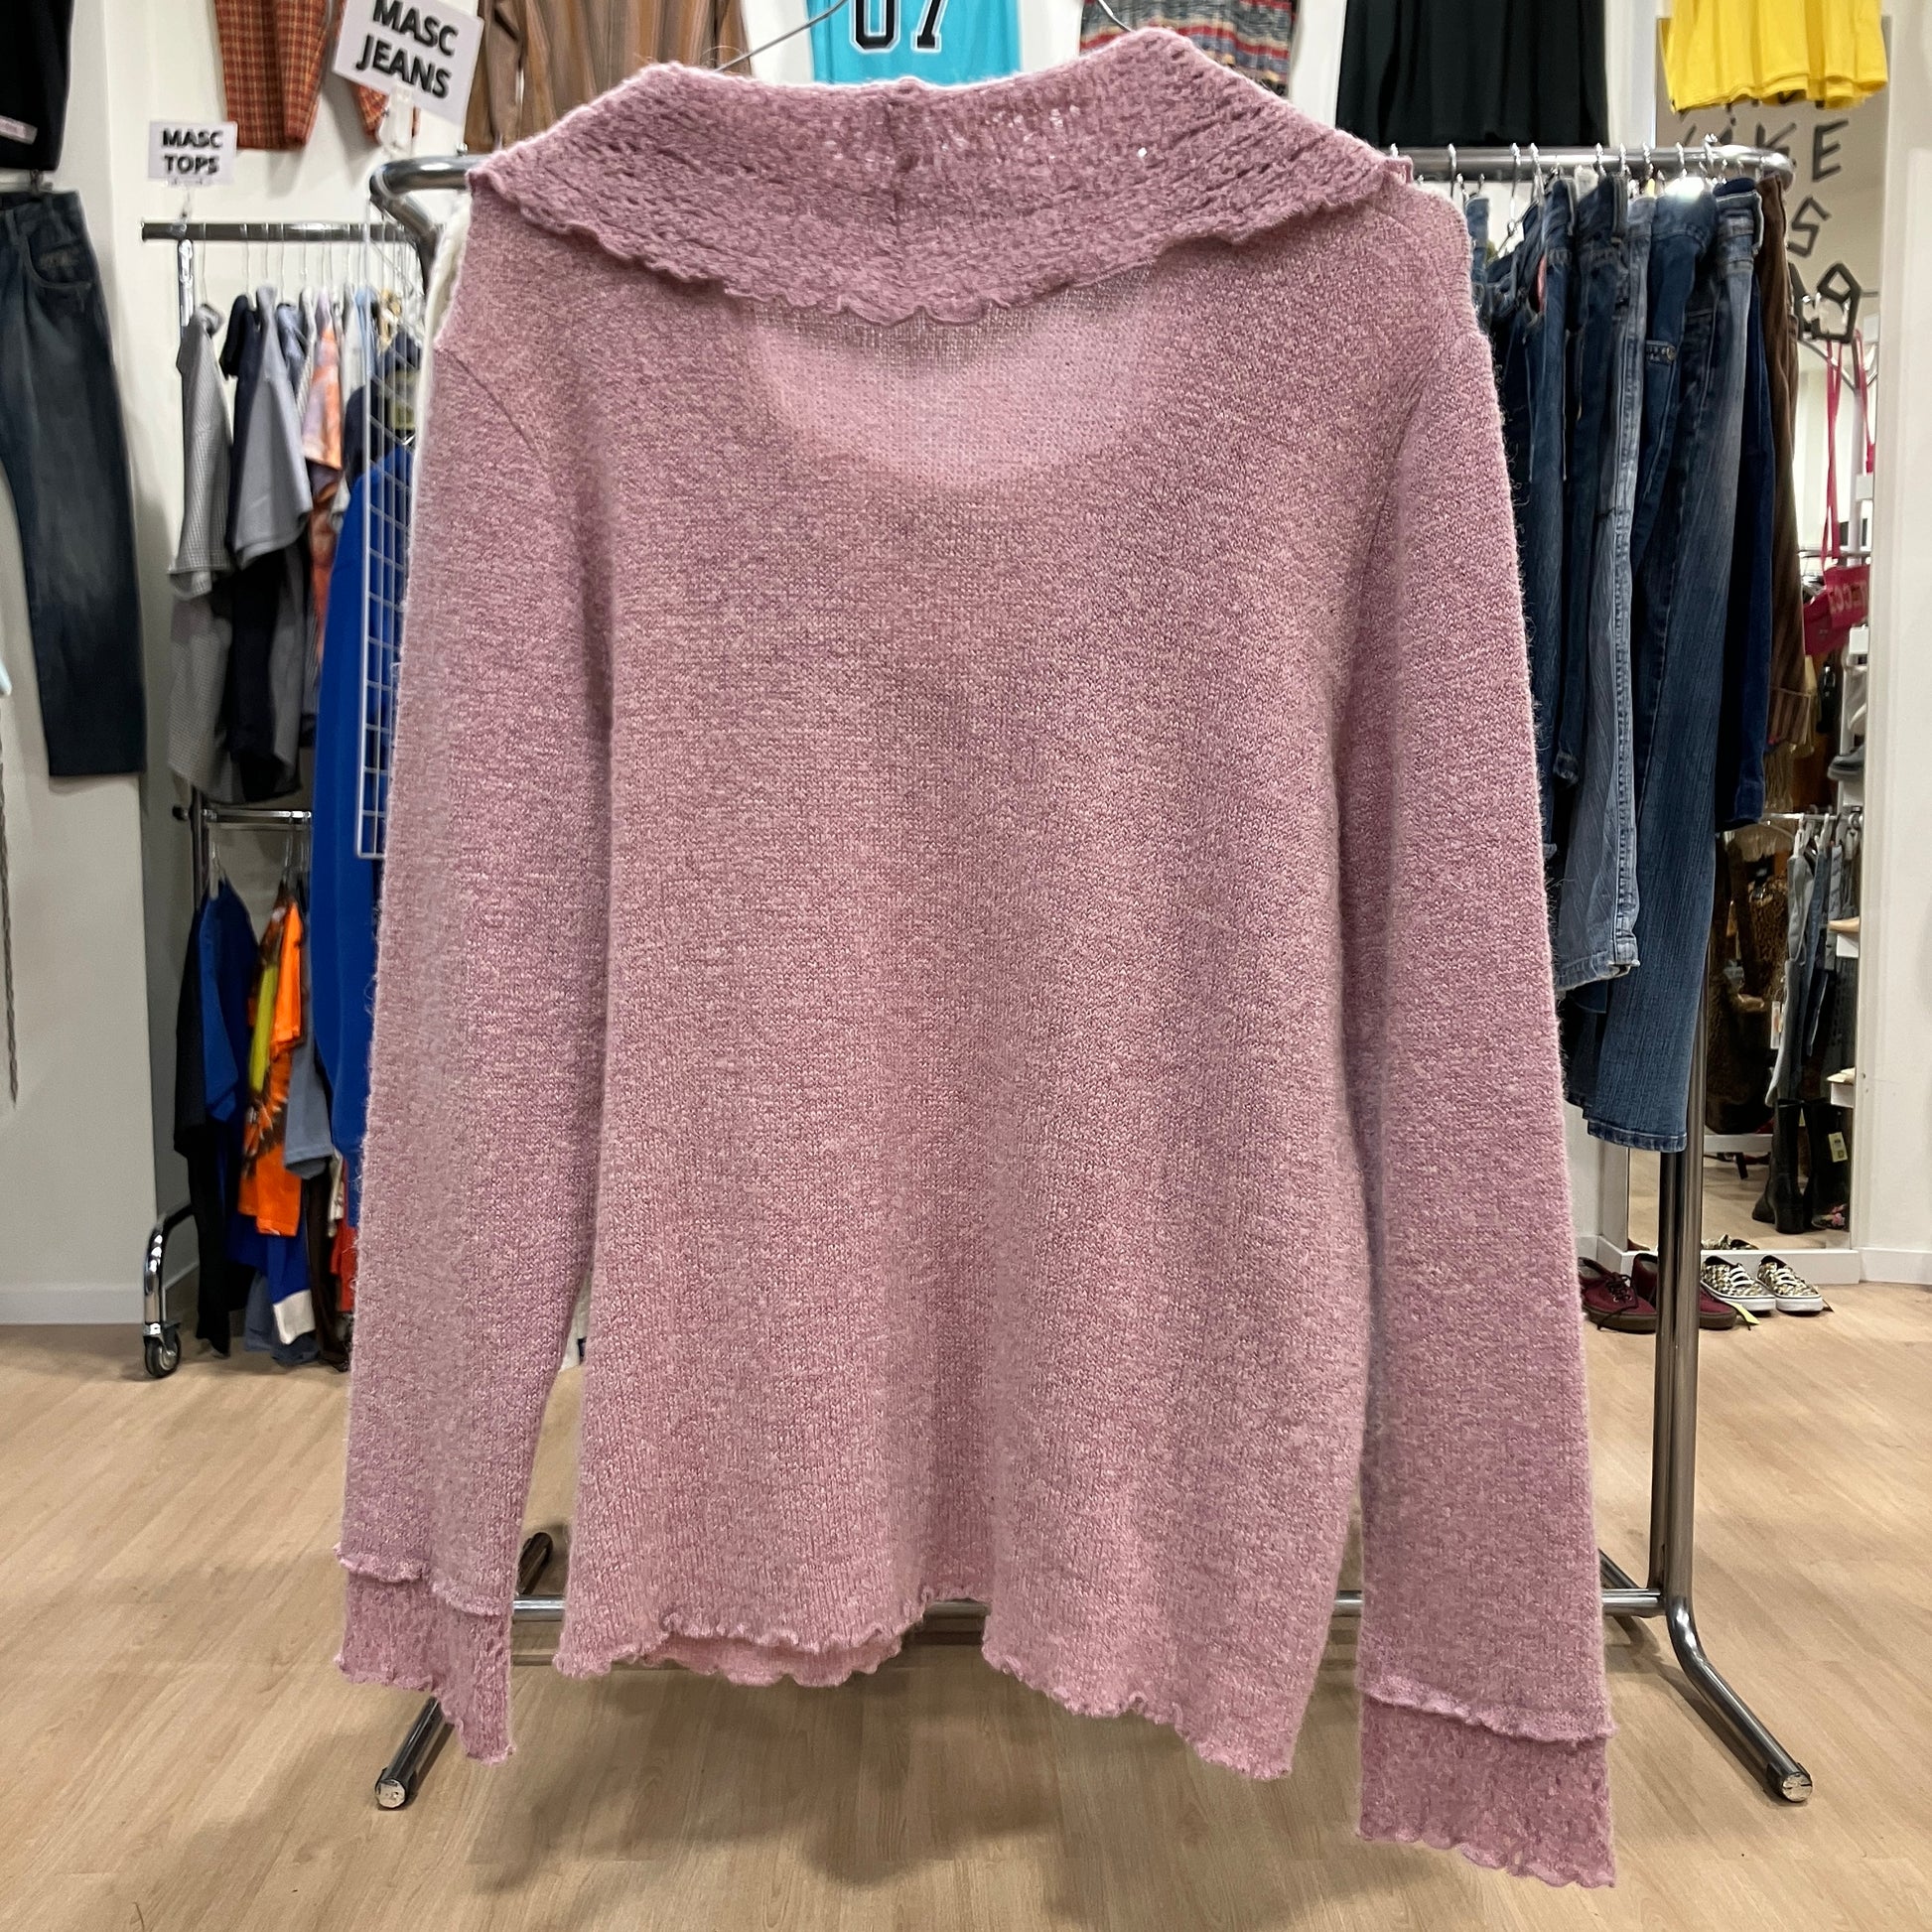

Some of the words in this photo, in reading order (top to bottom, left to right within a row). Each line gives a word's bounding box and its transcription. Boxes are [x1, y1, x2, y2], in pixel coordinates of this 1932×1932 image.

[373, 0, 459, 57] MASC
[355, 34, 452, 98] JEANS
[163, 128, 223, 148] MASC
[164, 155, 219, 175] TOPS
